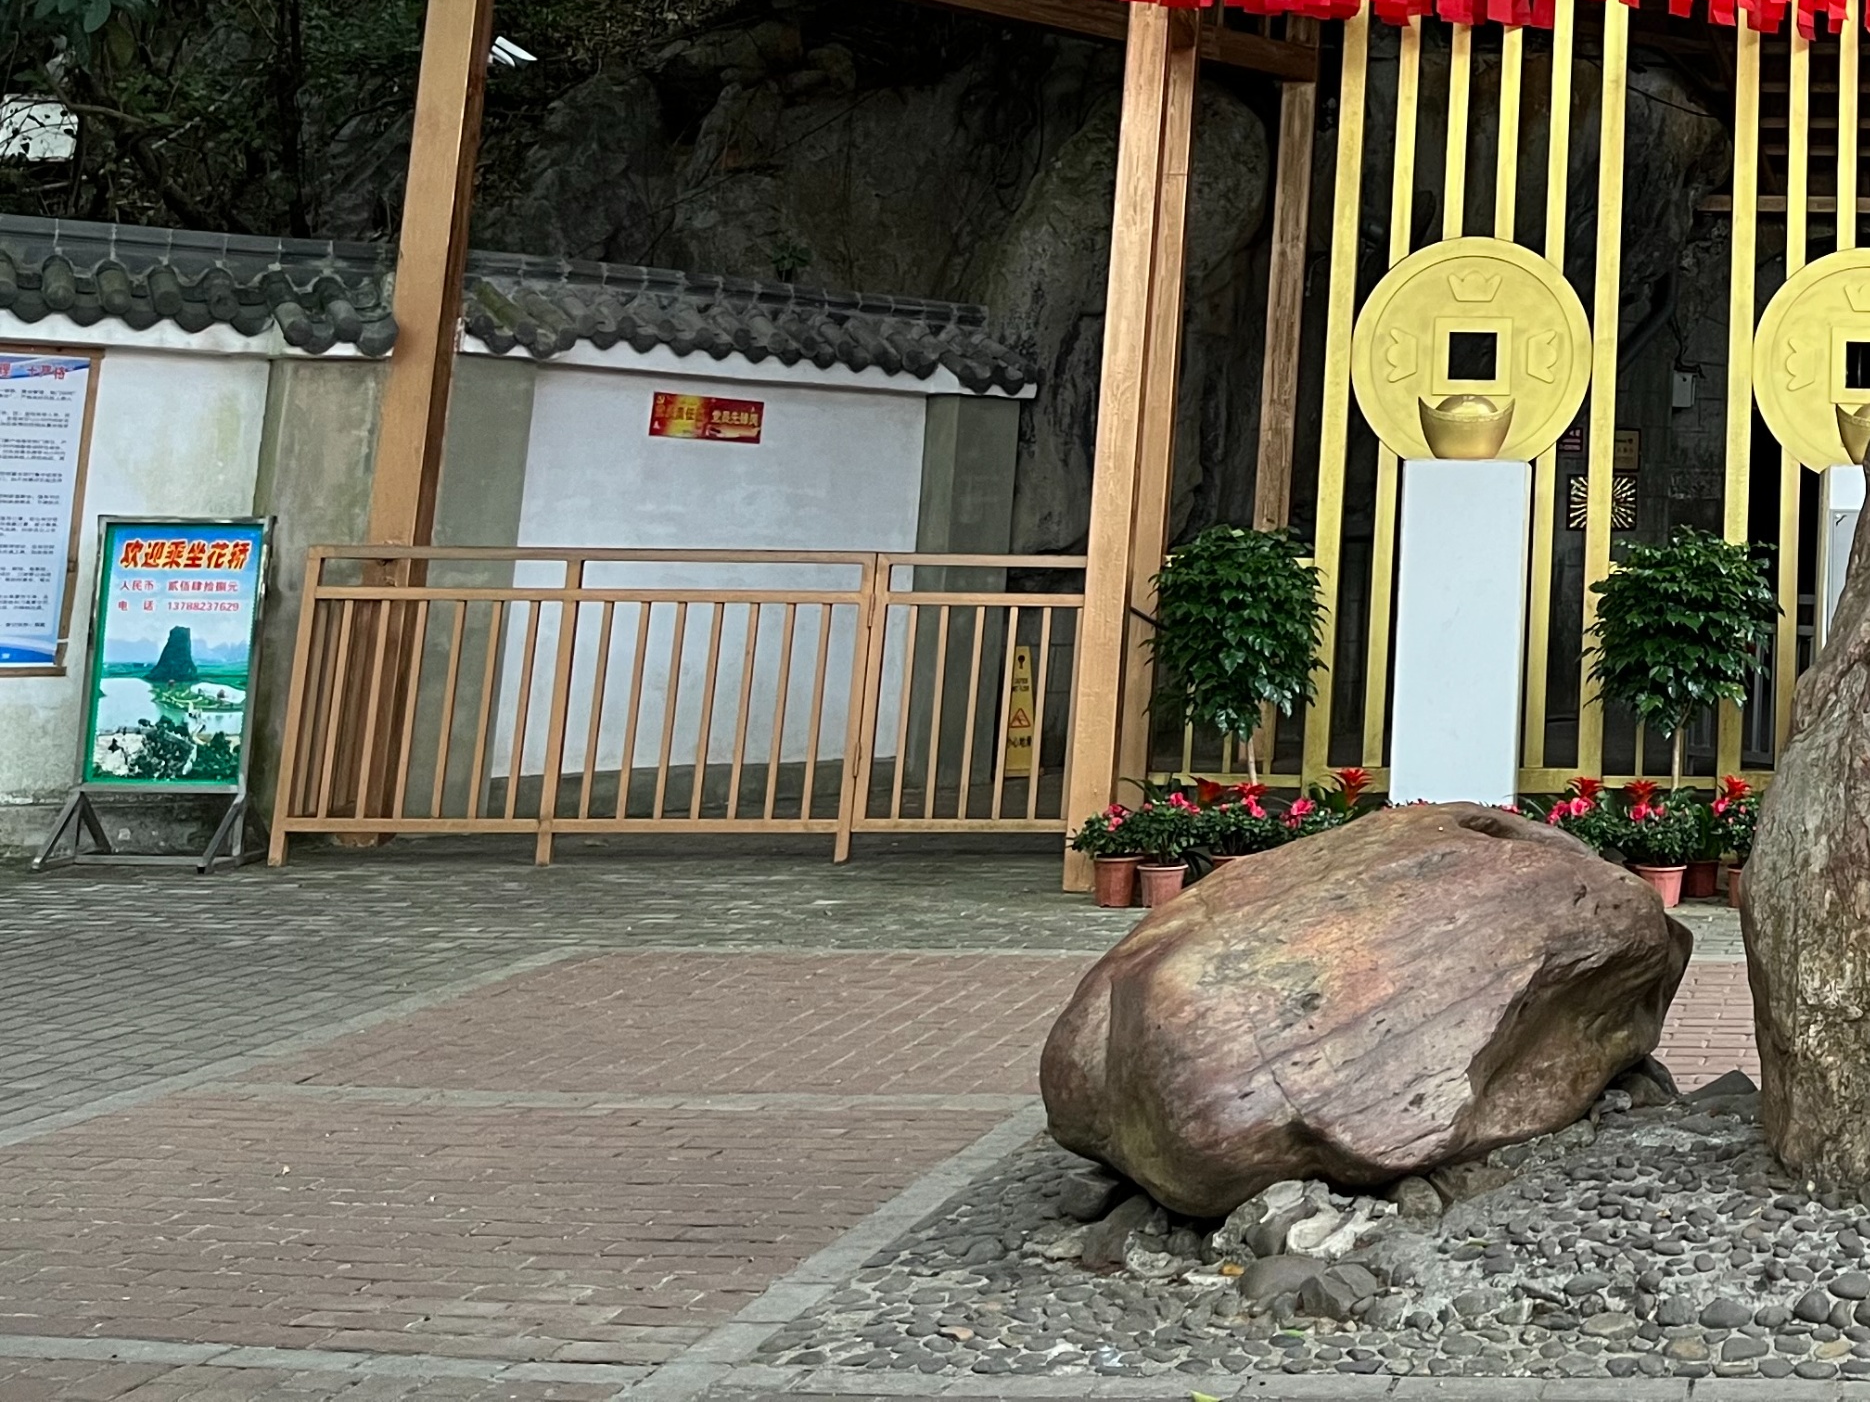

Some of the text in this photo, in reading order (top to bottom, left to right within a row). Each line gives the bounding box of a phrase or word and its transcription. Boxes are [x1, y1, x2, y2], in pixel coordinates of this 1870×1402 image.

[120, 539, 251, 570] 欢迎乘坐花轿
